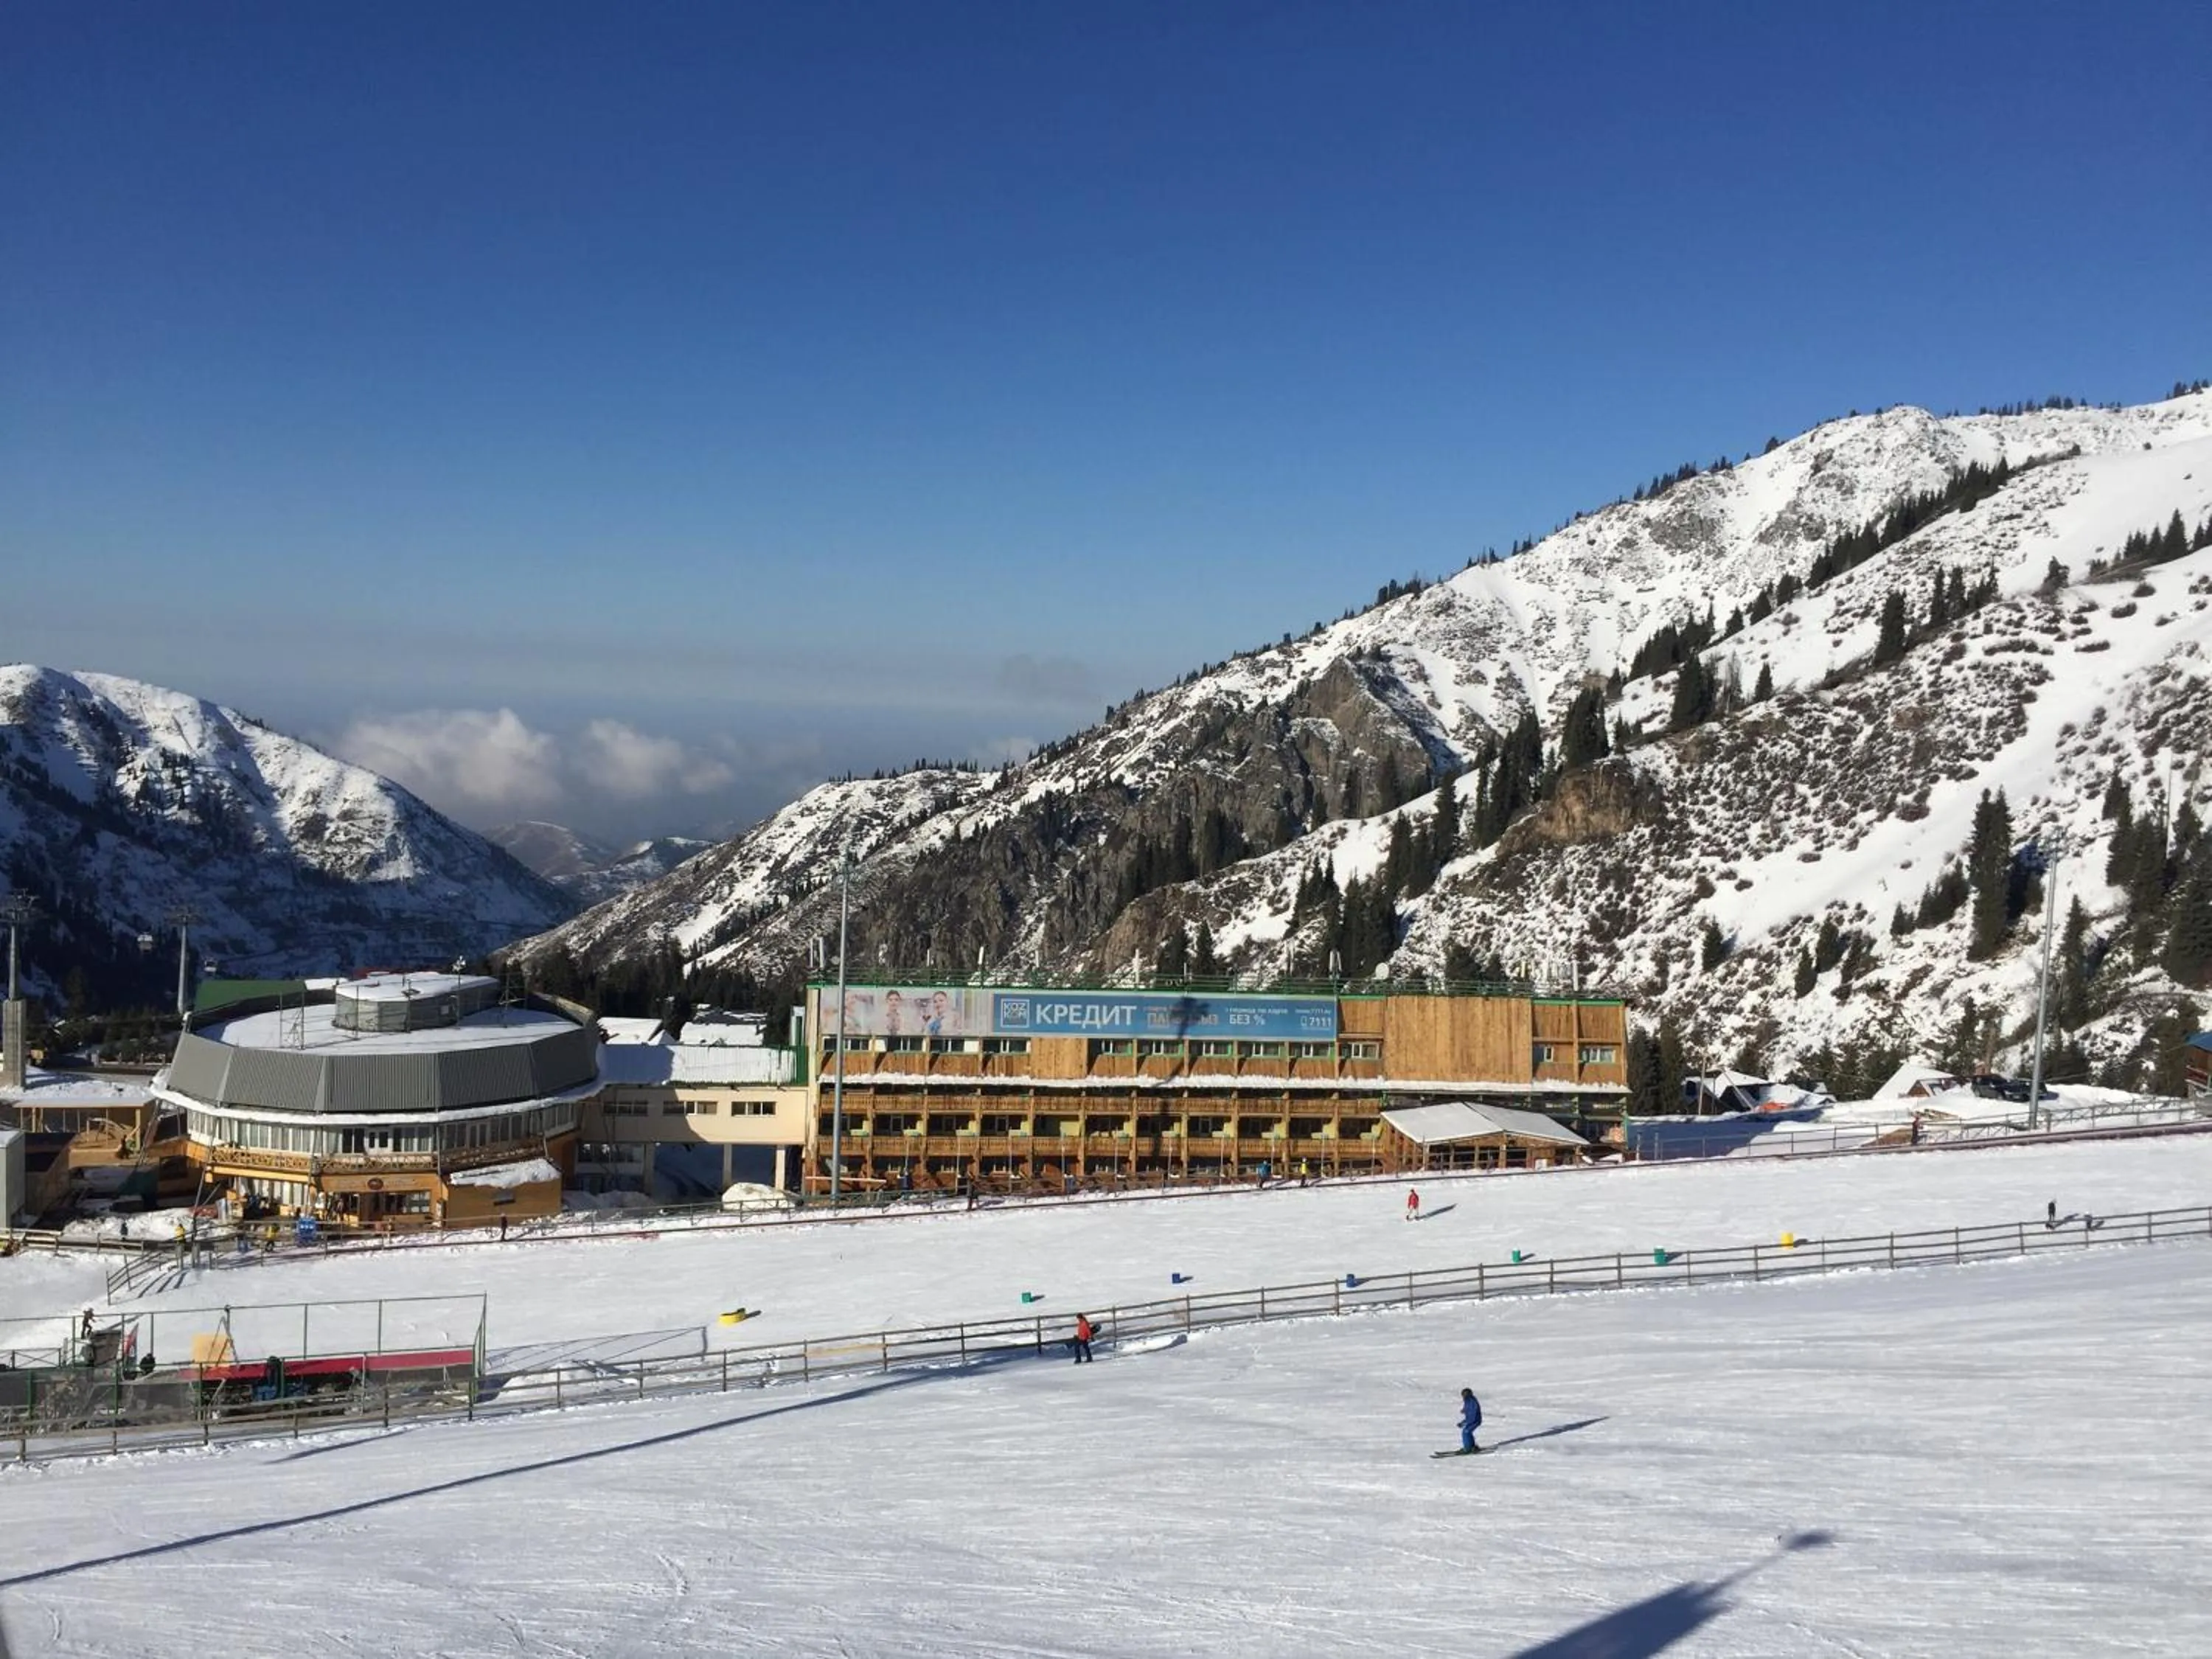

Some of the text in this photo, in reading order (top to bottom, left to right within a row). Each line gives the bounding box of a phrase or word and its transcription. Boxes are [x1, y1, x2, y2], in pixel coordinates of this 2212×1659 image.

[1036, 1004, 1137, 1029] КРЕДИТ
[1229, 1014, 1251, 1025] БЕЗ
[1253, 1014, 1266, 1026] %
[1309, 1017, 1332, 1027] 7111
